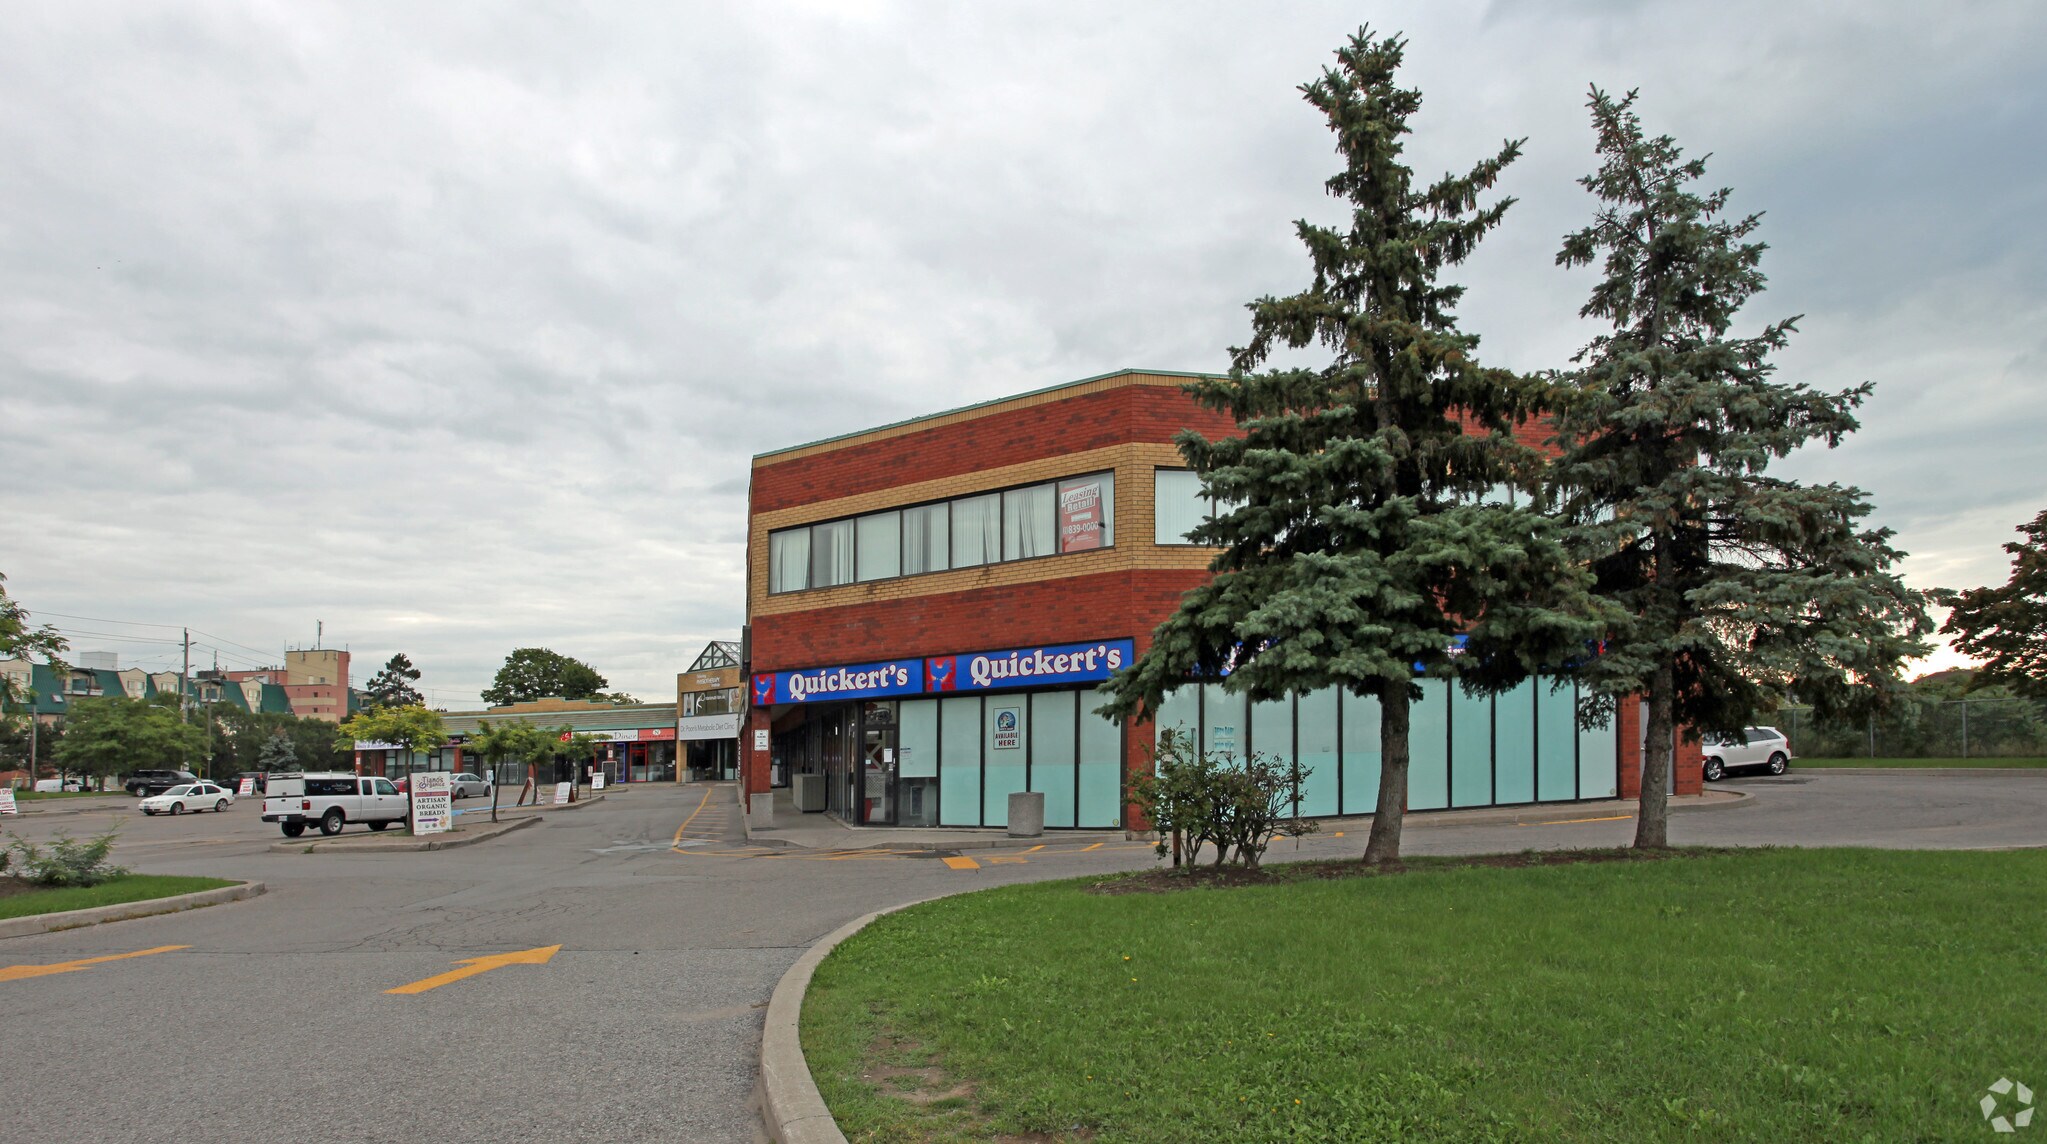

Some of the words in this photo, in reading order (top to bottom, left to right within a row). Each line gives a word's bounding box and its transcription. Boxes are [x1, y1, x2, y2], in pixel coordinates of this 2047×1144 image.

[1062, 486, 1098, 504] Leasing
[1066, 497, 1095, 512] Retail
[970, 645, 1121, 687] Quickert's
[788, 665, 909, 701] Quickert's
[998, 739, 1016, 747] HERE
